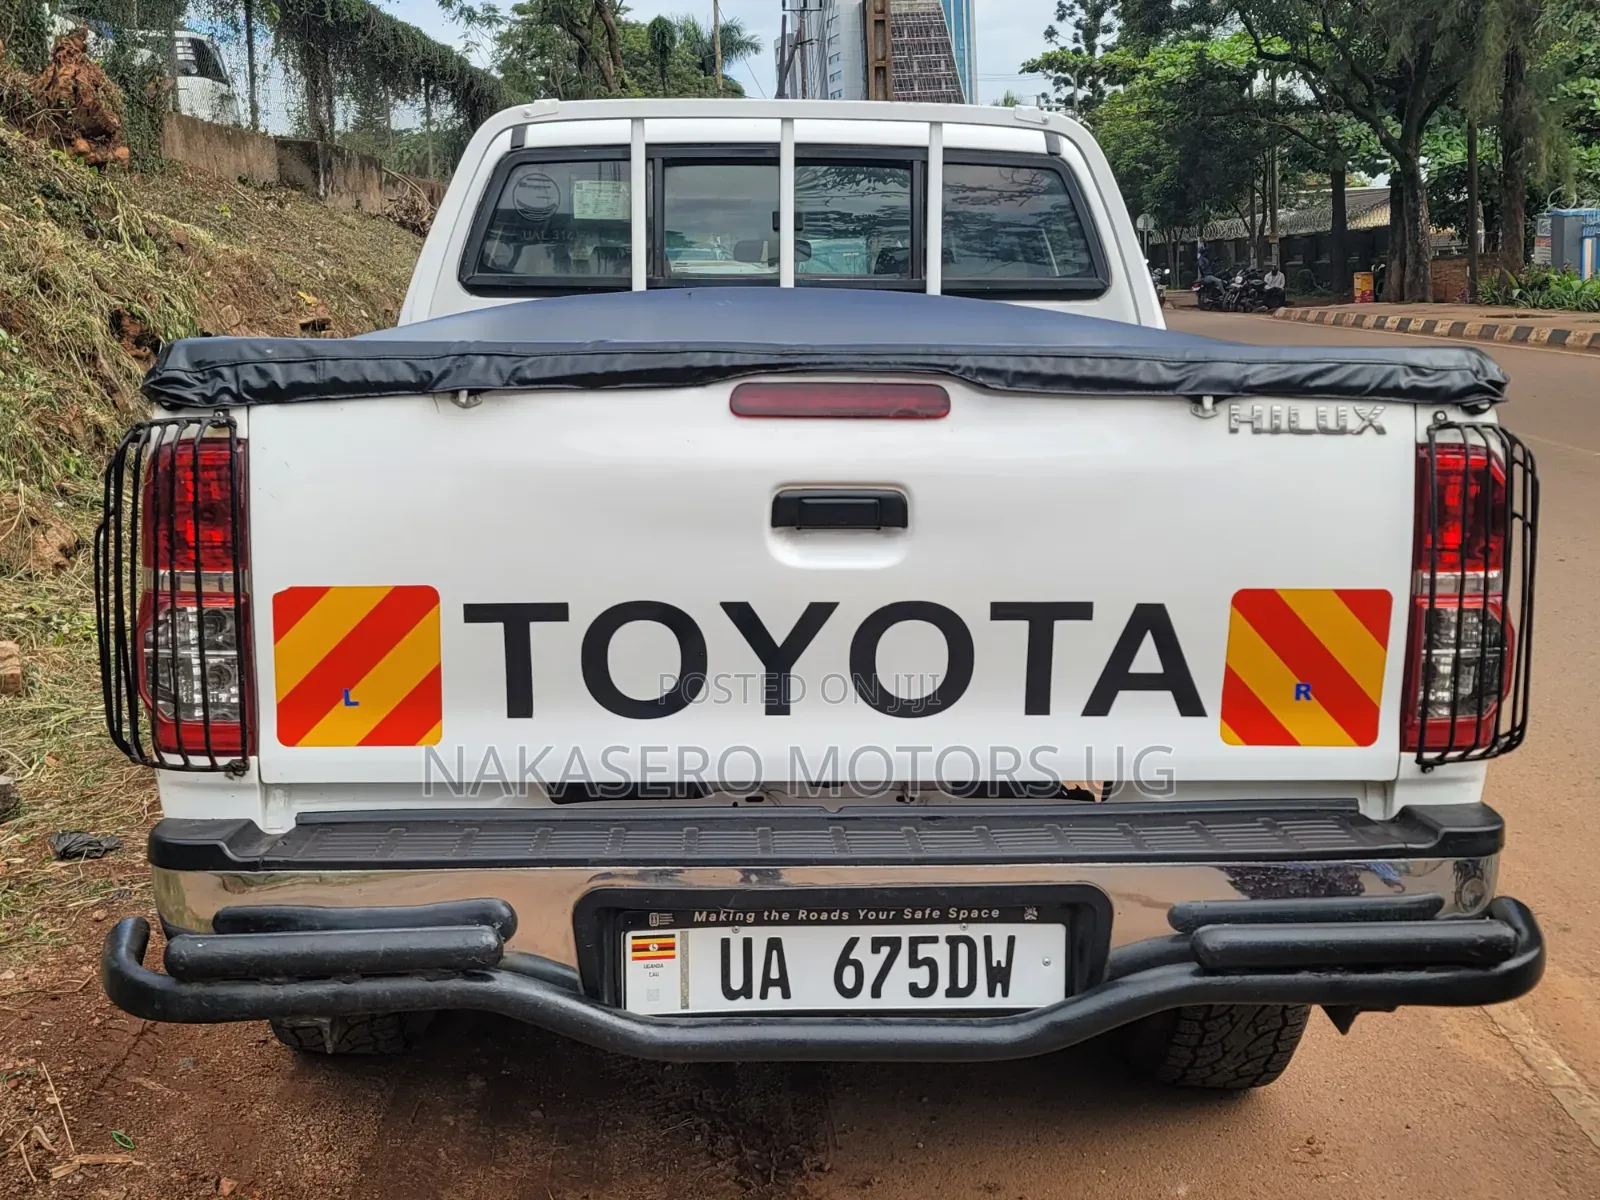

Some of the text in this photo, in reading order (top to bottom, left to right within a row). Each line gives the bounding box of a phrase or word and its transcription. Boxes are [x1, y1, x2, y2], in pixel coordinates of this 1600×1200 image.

[1229, 404, 1387, 435] HILUX
[463, 600, 1208, 719] TOYOTA
[343, 688, 360, 706] L
[1295, 683, 1312, 701] R
[694, 907, 1000, 923] Making the Roads Your Safe Space
[720, 935, 1016, 1000] UA 675DW
